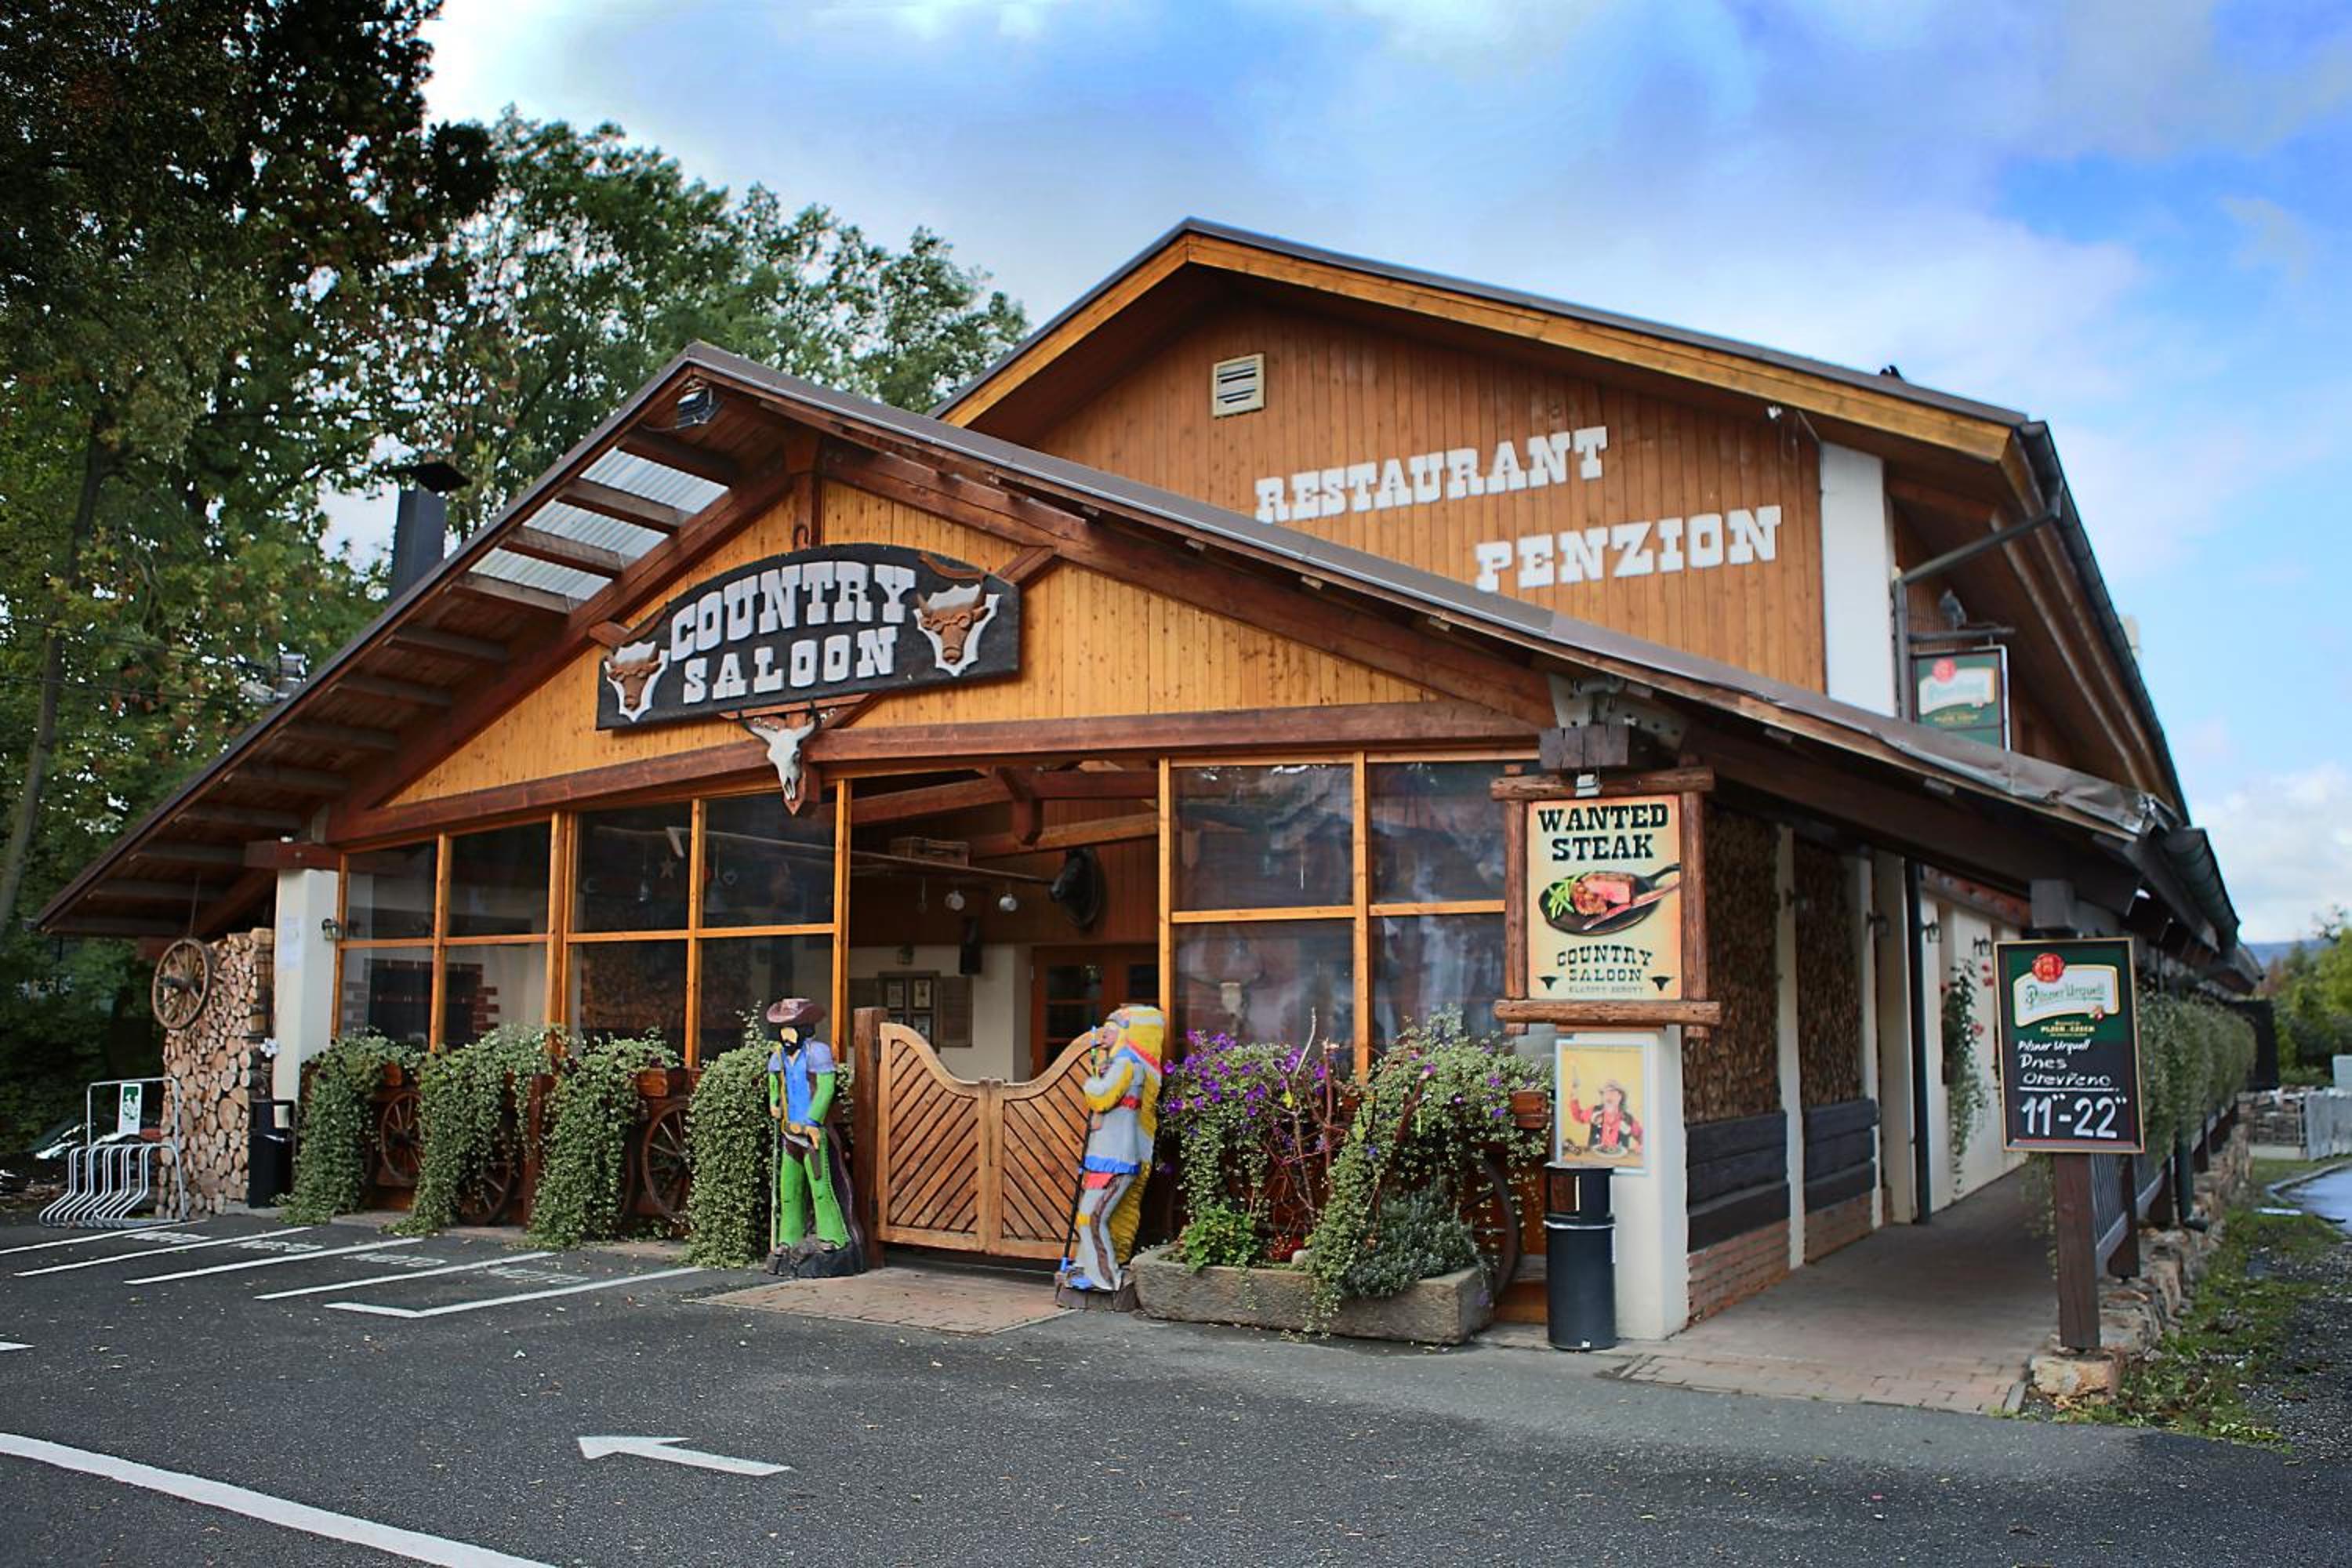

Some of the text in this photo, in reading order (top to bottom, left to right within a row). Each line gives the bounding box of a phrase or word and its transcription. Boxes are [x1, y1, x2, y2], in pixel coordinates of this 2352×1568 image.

[1255, 426, 1607, 524] RESTAURANT
[1475, 505, 1781, 592] PENZION
[670, 561, 916, 662] COUNTRY
[683, 626, 897, 704] SALOON
[1537, 803, 1669, 832] WANTED
[1552, 834, 1653, 861] STEAK
[1556, 945, 1653, 967] COUNTRY
[1569, 968, 1642, 982] SALOON
[2020, 1053, 2067, 1069] Dnes
